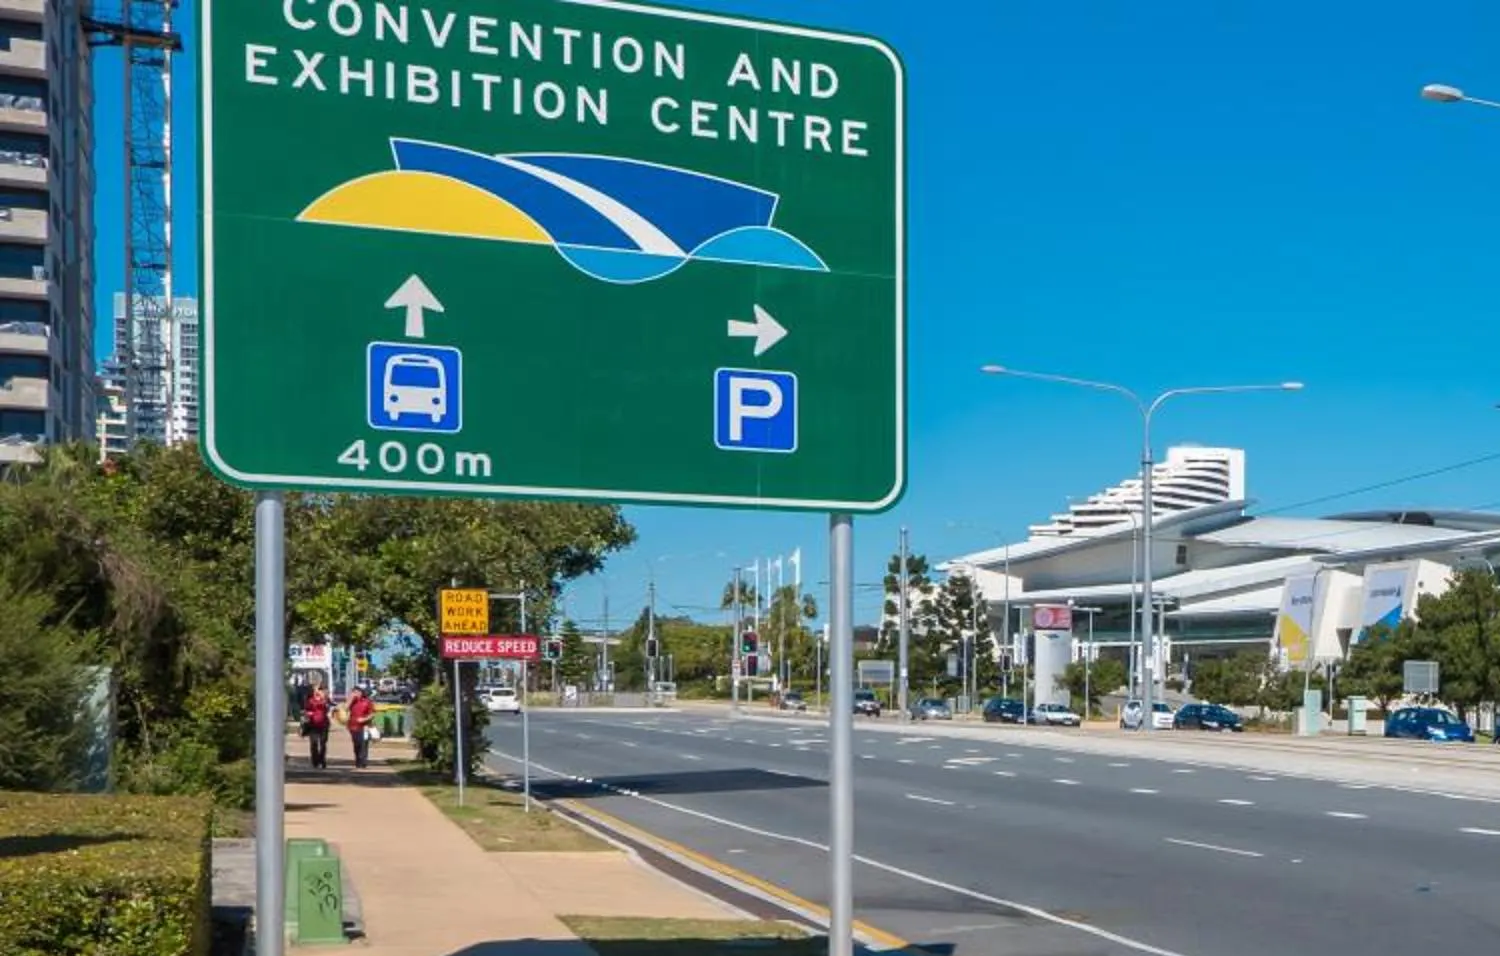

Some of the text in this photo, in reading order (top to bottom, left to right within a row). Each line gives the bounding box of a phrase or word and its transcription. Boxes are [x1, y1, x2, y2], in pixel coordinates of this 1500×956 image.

[284, 0, 839, 98] CONVENTION AND
[245, 44, 868, 157] EXHIBITION CENTRE
[729, 376, 783, 441] P
[337, 440, 491, 477] 400m
[446, 592, 484, 603] ROAD
[446, 606, 484, 617] WORK
[444, 621, 486, 631] AHEAD
[445, 639, 537, 653] REDUCE SPEED
